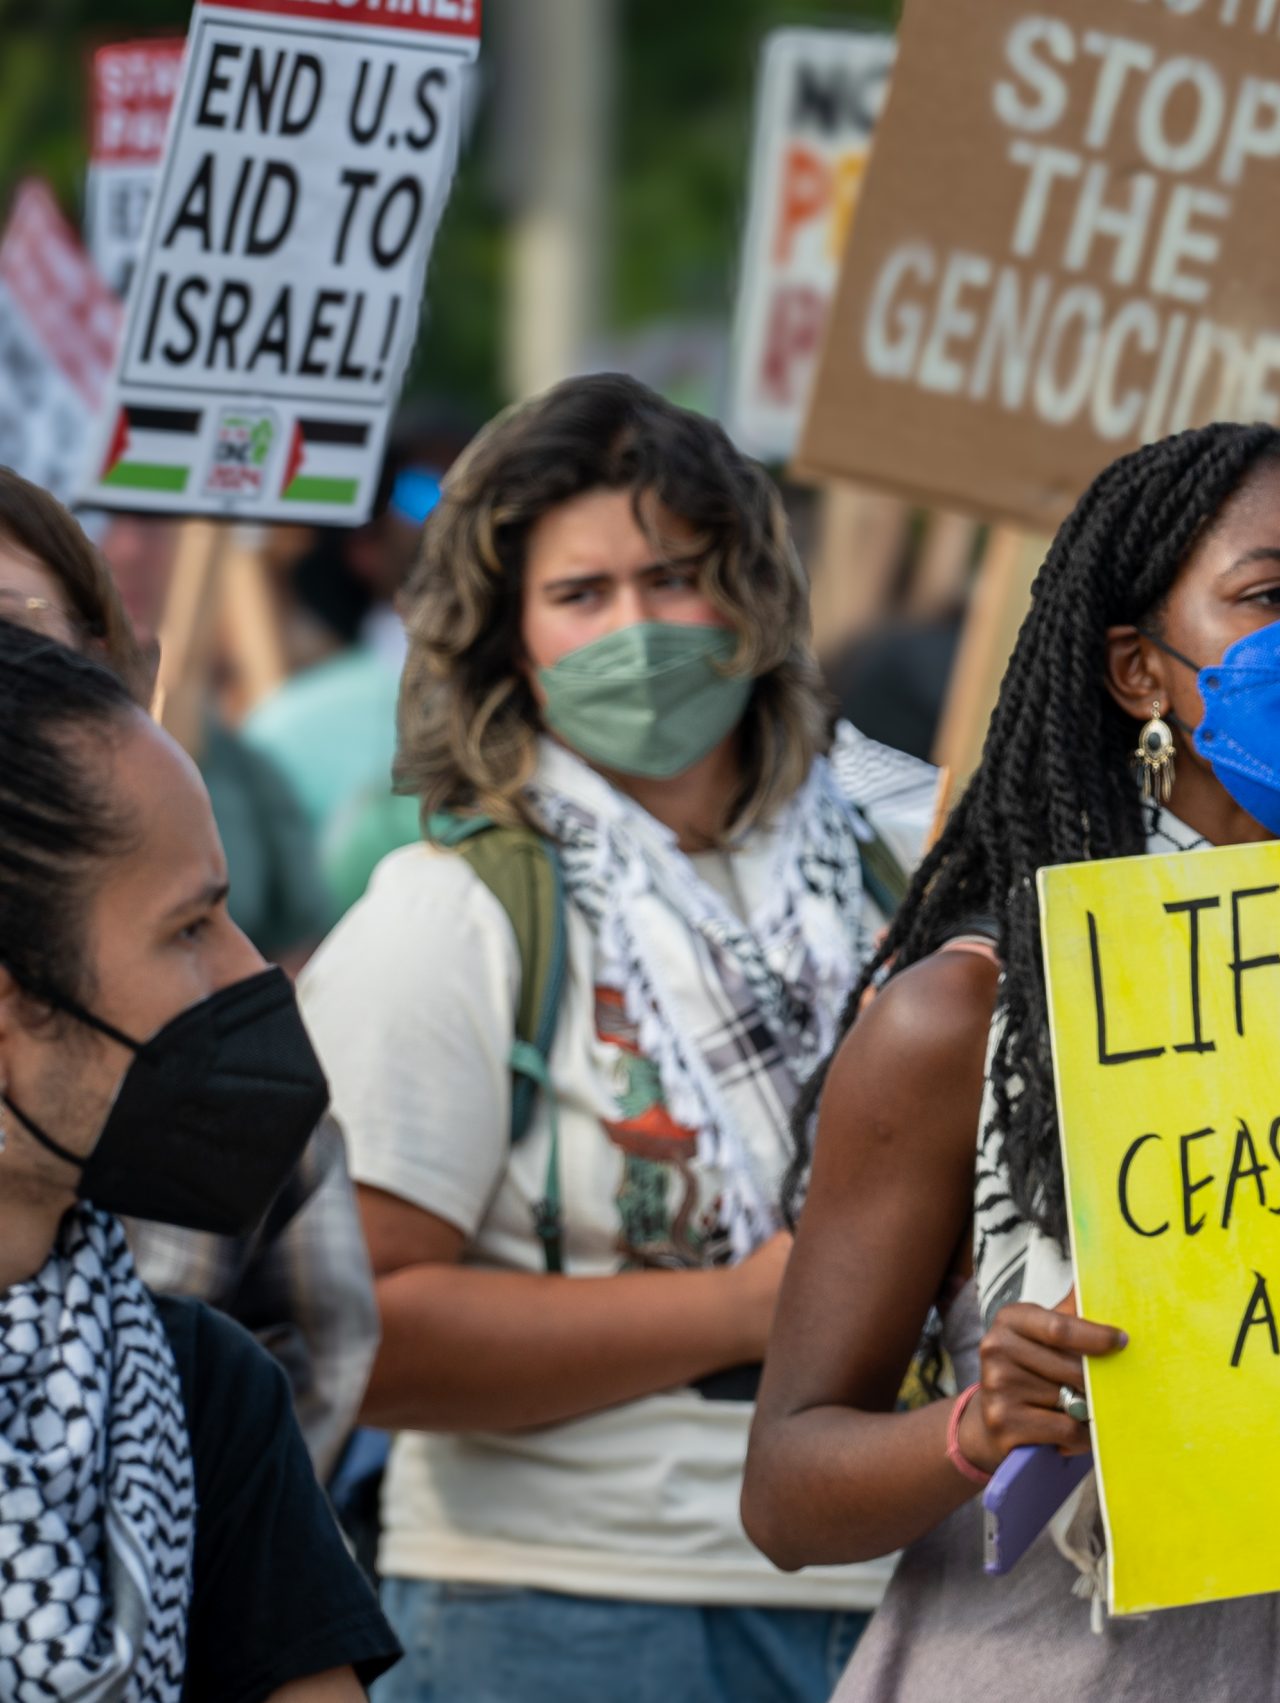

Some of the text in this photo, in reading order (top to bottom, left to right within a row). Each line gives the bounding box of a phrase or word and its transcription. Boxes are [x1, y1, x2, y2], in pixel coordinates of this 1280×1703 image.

[195, 43, 323, 138] END
[348, 59, 447, 150] U.S
[162, 153, 301, 257] AID
[333, 171, 424, 270] TO
[1010, 141, 1231, 302] THE
[139, 272, 402, 384] ISRAEL!
